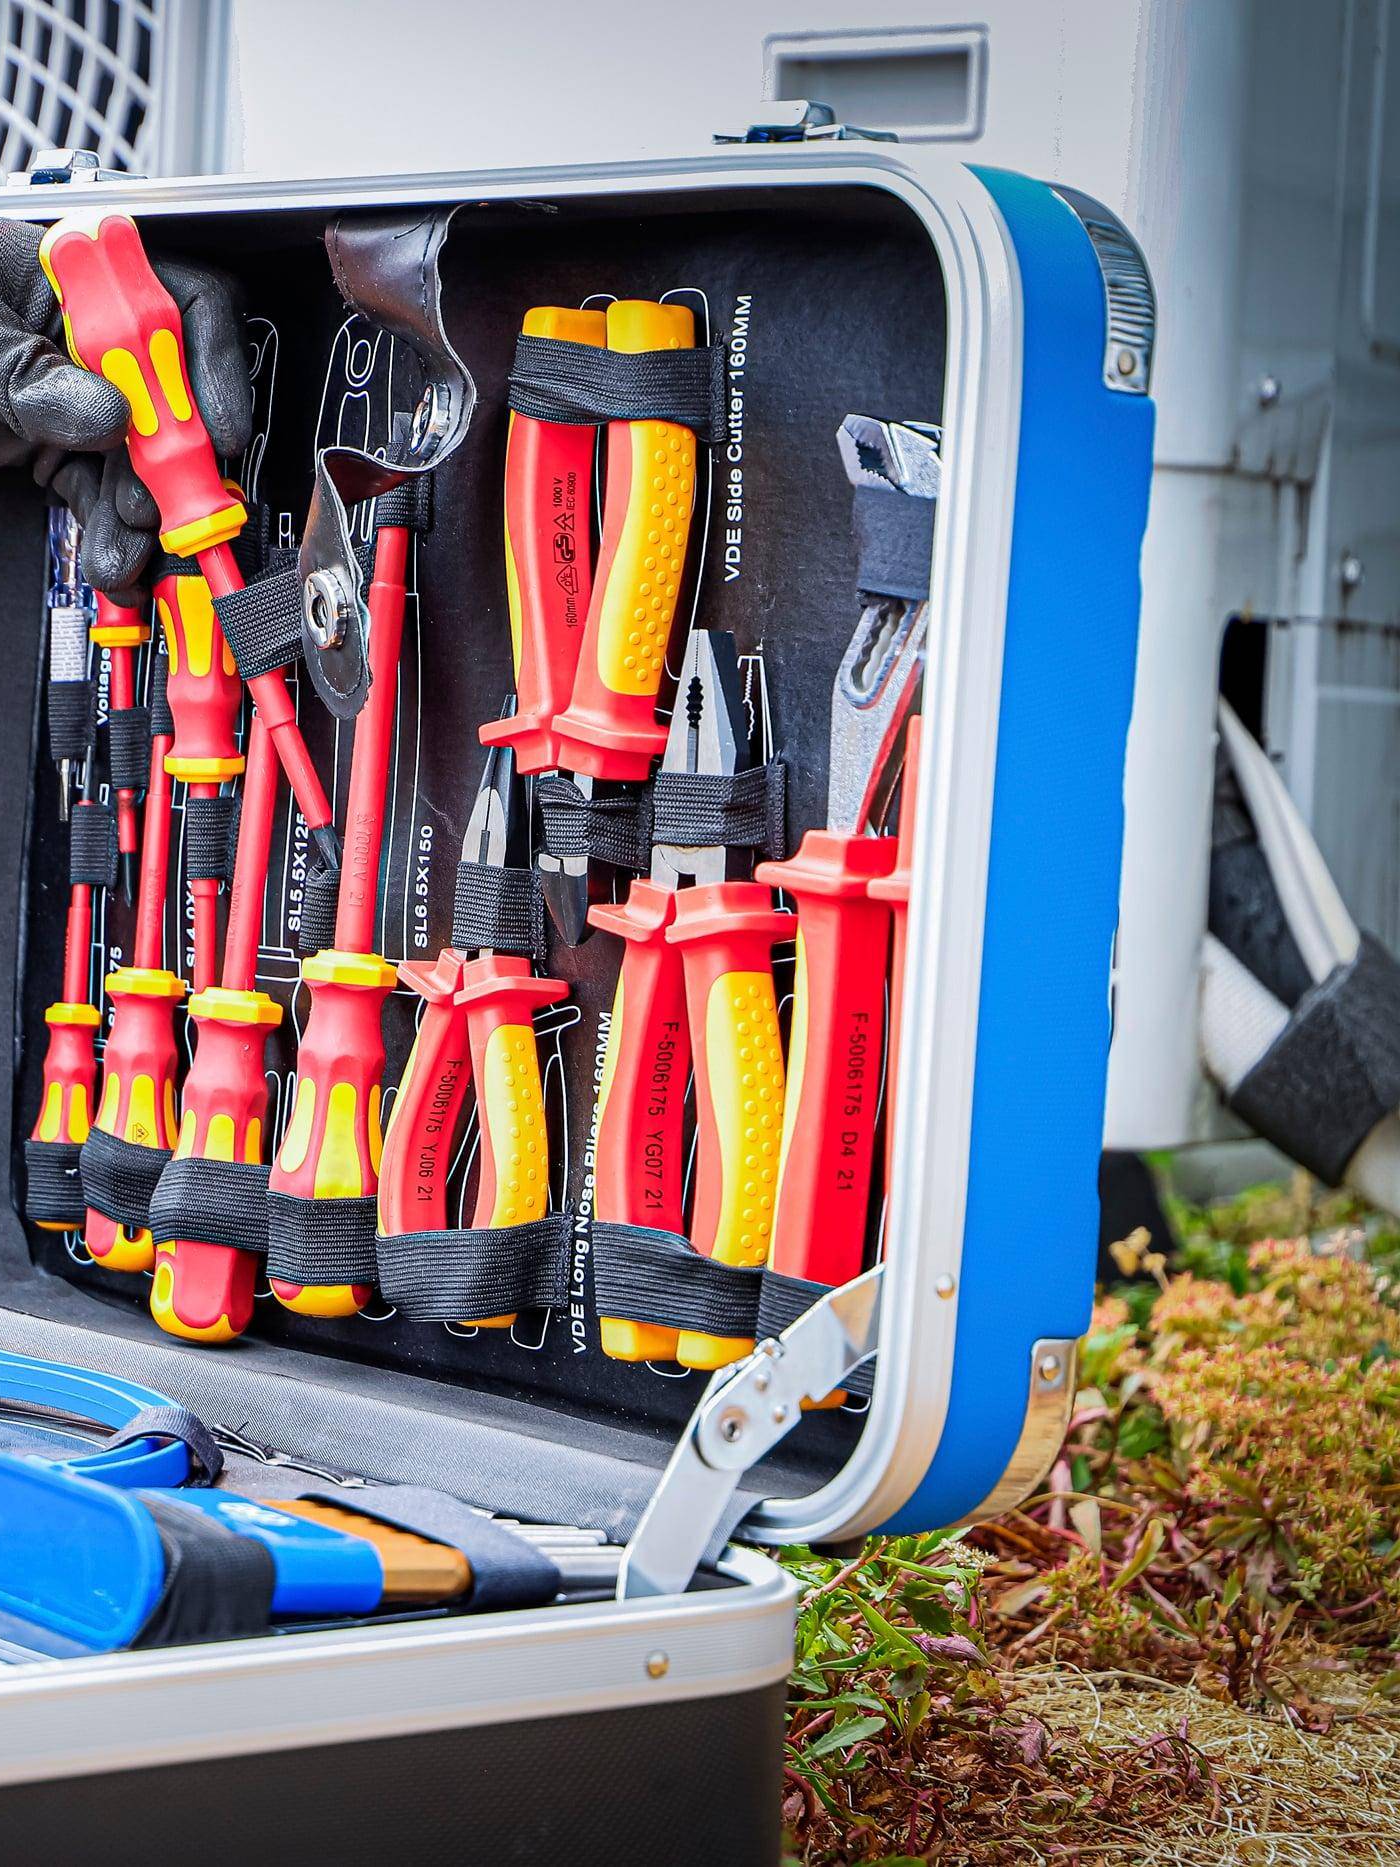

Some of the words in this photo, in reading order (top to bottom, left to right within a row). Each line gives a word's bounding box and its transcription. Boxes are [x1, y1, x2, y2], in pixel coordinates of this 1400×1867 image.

[728, 295, 752, 380] 160MM
[726, 387, 745, 462] Cutter
[553, 486, 563, 507] 1000
[566, 494, 575, 510] IEC
[567, 472, 576, 494] 60900
[726, 467, 743, 522] Side
[724, 527, 742, 582] VDE
[566, 597, 578, 628] 160mm
[96, 647, 112, 726] Voltage
[414, 825, 434, 948] SL6.5X150
[647, 1021, 680, 1117] F-5006175
[843, 1012, 869, 1117] F-5006175
[425, 1060, 463, 1133] F-5006175
[418, 1142, 439, 1178] YJ06
[644, 1130, 664, 1181] YG07
[840, 1131, 859, 1157] D4
[417, 1185, 434, 1201] 21
[574, 1174, 595, 1231] Nose
[645, 1189, 662, 1210] 21
[837, 1169, 855, 1190] 21
[571, 1234, 590, 1294] Long
[573, 1300, 586, 1355] VDE
